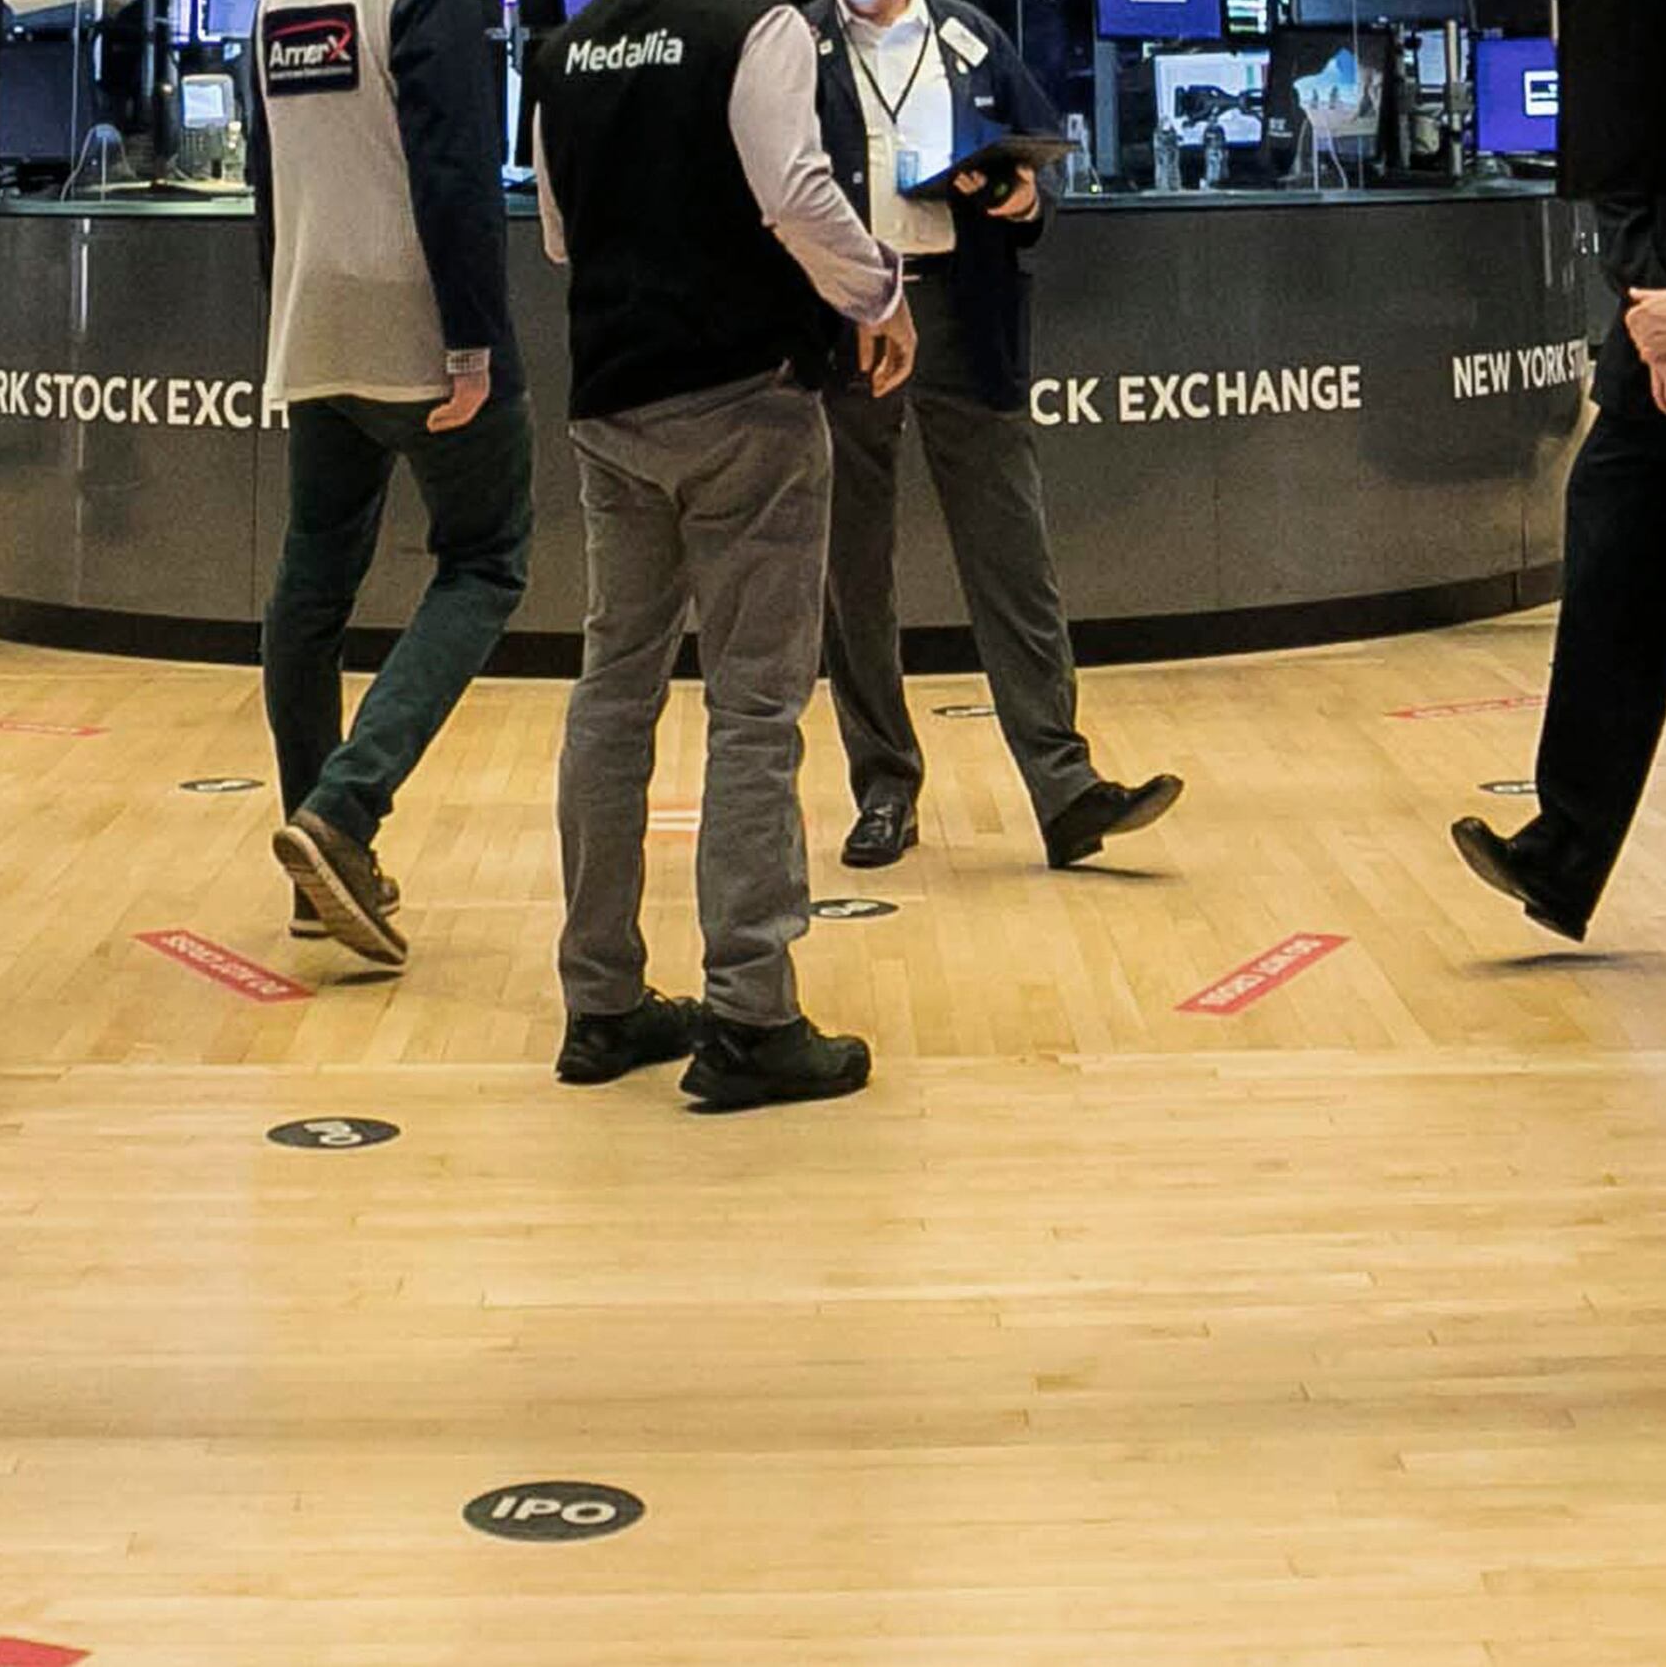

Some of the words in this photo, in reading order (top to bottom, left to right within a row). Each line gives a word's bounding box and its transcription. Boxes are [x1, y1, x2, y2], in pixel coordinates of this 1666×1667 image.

[565, 28, 684, 75] Medallia
[1118, 365, 1361, 424] EXCHANGE
[1452, 351, 1511, 399] NEW
[1517, 343, 1566, 390] YORK
[35, 372, 159, 424] STOCK
[492, 1496, 616, 1527] IPO
